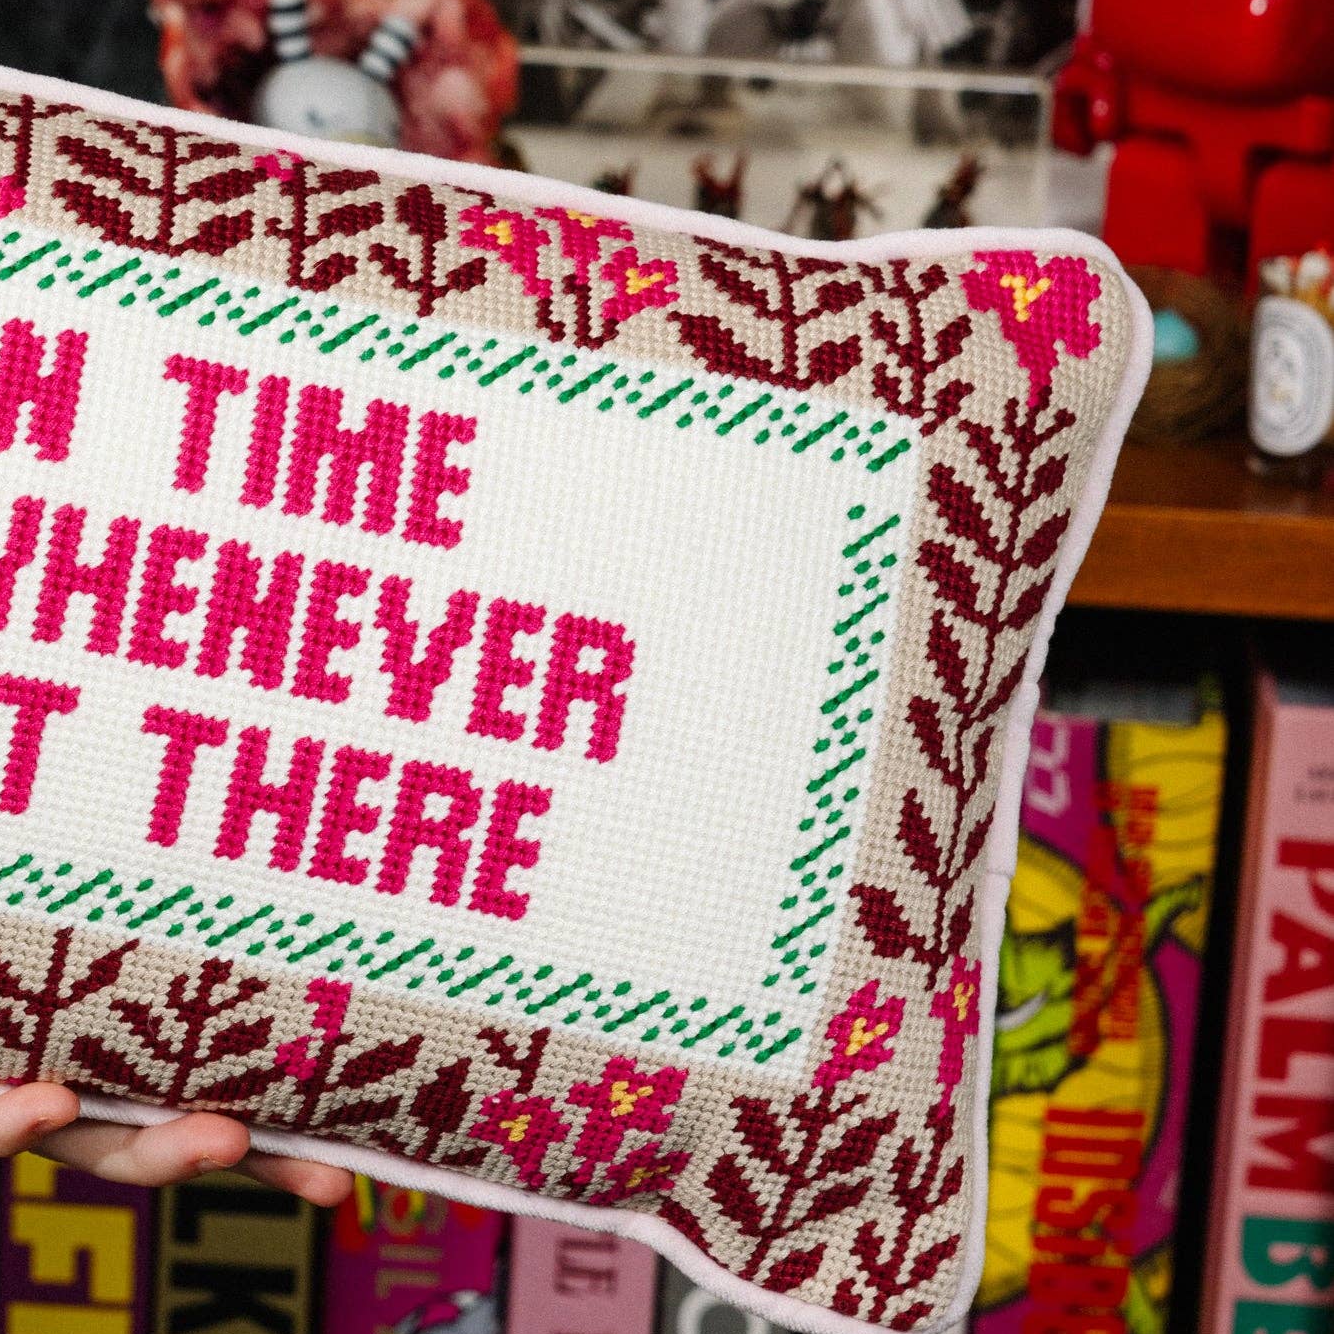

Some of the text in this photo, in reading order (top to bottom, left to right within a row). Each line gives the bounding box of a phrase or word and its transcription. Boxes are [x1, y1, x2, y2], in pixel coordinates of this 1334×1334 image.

[163, 353, 477, 550] TIME
[141, 704, 553, 920] THERE
[1246, 837, 1334, 1194] PALM
